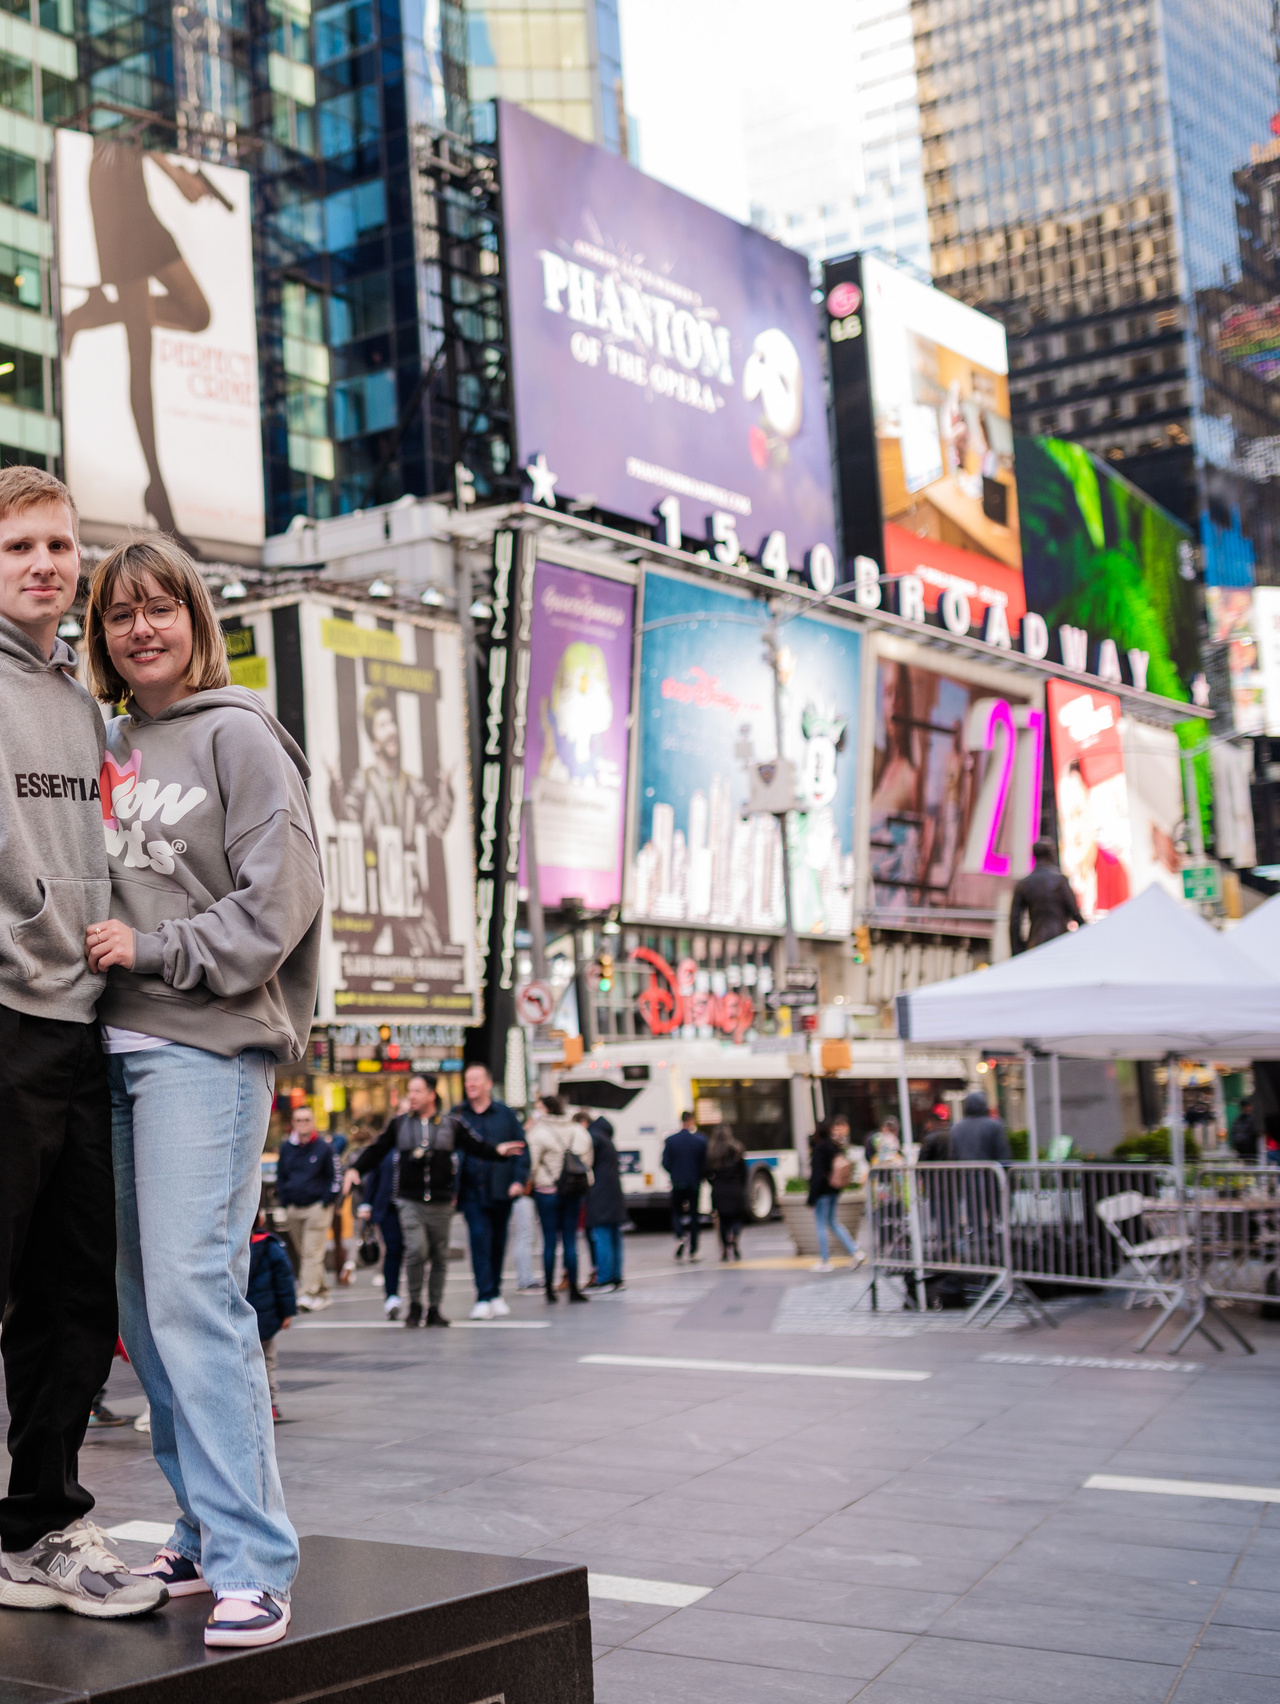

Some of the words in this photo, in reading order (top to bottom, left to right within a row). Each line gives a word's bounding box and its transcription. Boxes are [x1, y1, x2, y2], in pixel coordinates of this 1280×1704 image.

[537, 249, 734, 385] PHANTOM
[830, 314, 862, 342] LG
[571, 332, 602, 367] OF
[604, 344, 649, 387] THE
[649, 363, 718, 413] OPERA
[658, 495, 835, 596] 1540
[854, 555, 1150, 692] BROADWAY
[962, 697, 1044, 880] 21
[48, 1552, 77, 1579] N
